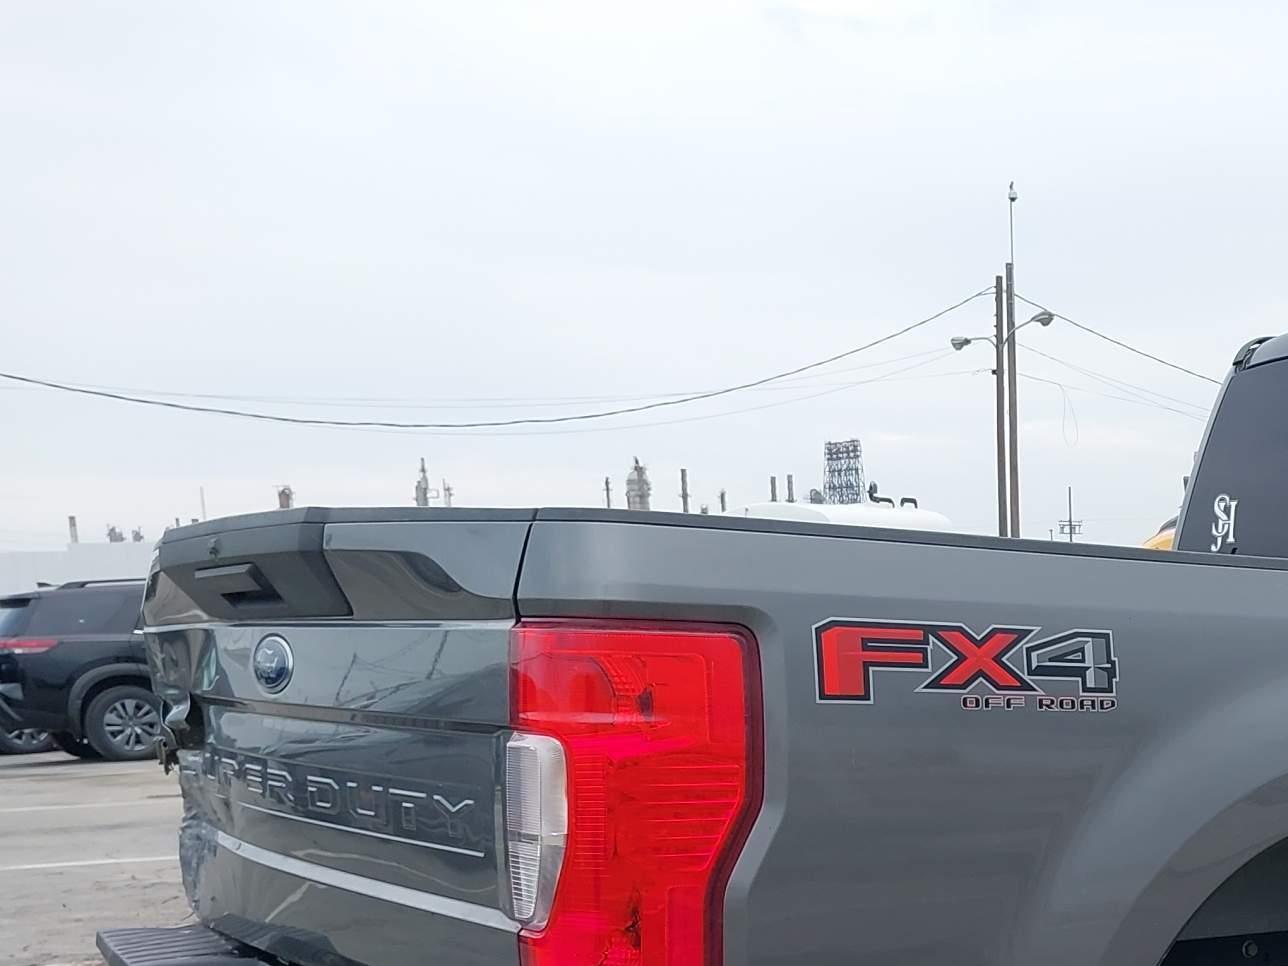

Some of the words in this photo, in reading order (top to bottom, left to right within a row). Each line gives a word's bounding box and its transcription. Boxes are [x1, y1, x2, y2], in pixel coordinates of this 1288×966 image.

[811, 616, 1119, 705] FX4
[960, 693, 1026, 712] OFF
[1035, 694, 1118, 713] ROAD
[306, 773, 476, 838] DUTY
